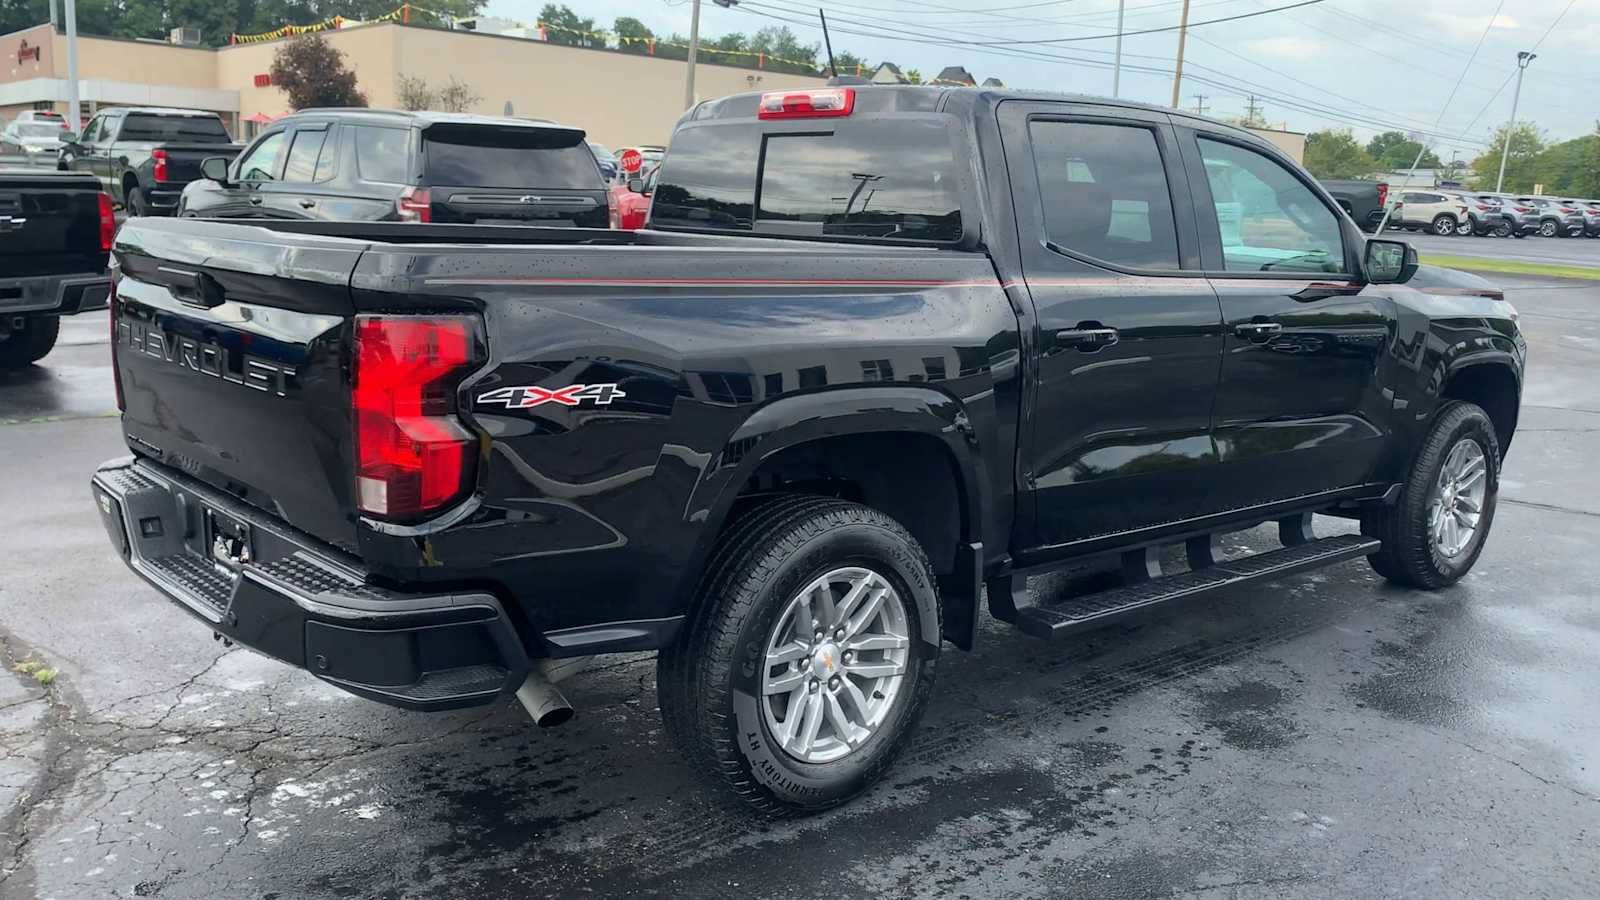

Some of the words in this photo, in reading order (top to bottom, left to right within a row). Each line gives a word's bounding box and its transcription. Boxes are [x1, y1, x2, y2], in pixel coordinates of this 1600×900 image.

[623, 154, 642, 168] STOP
[116, 318, 297, 398] CHEVROLET
[746, 732, 761, 751] HT
